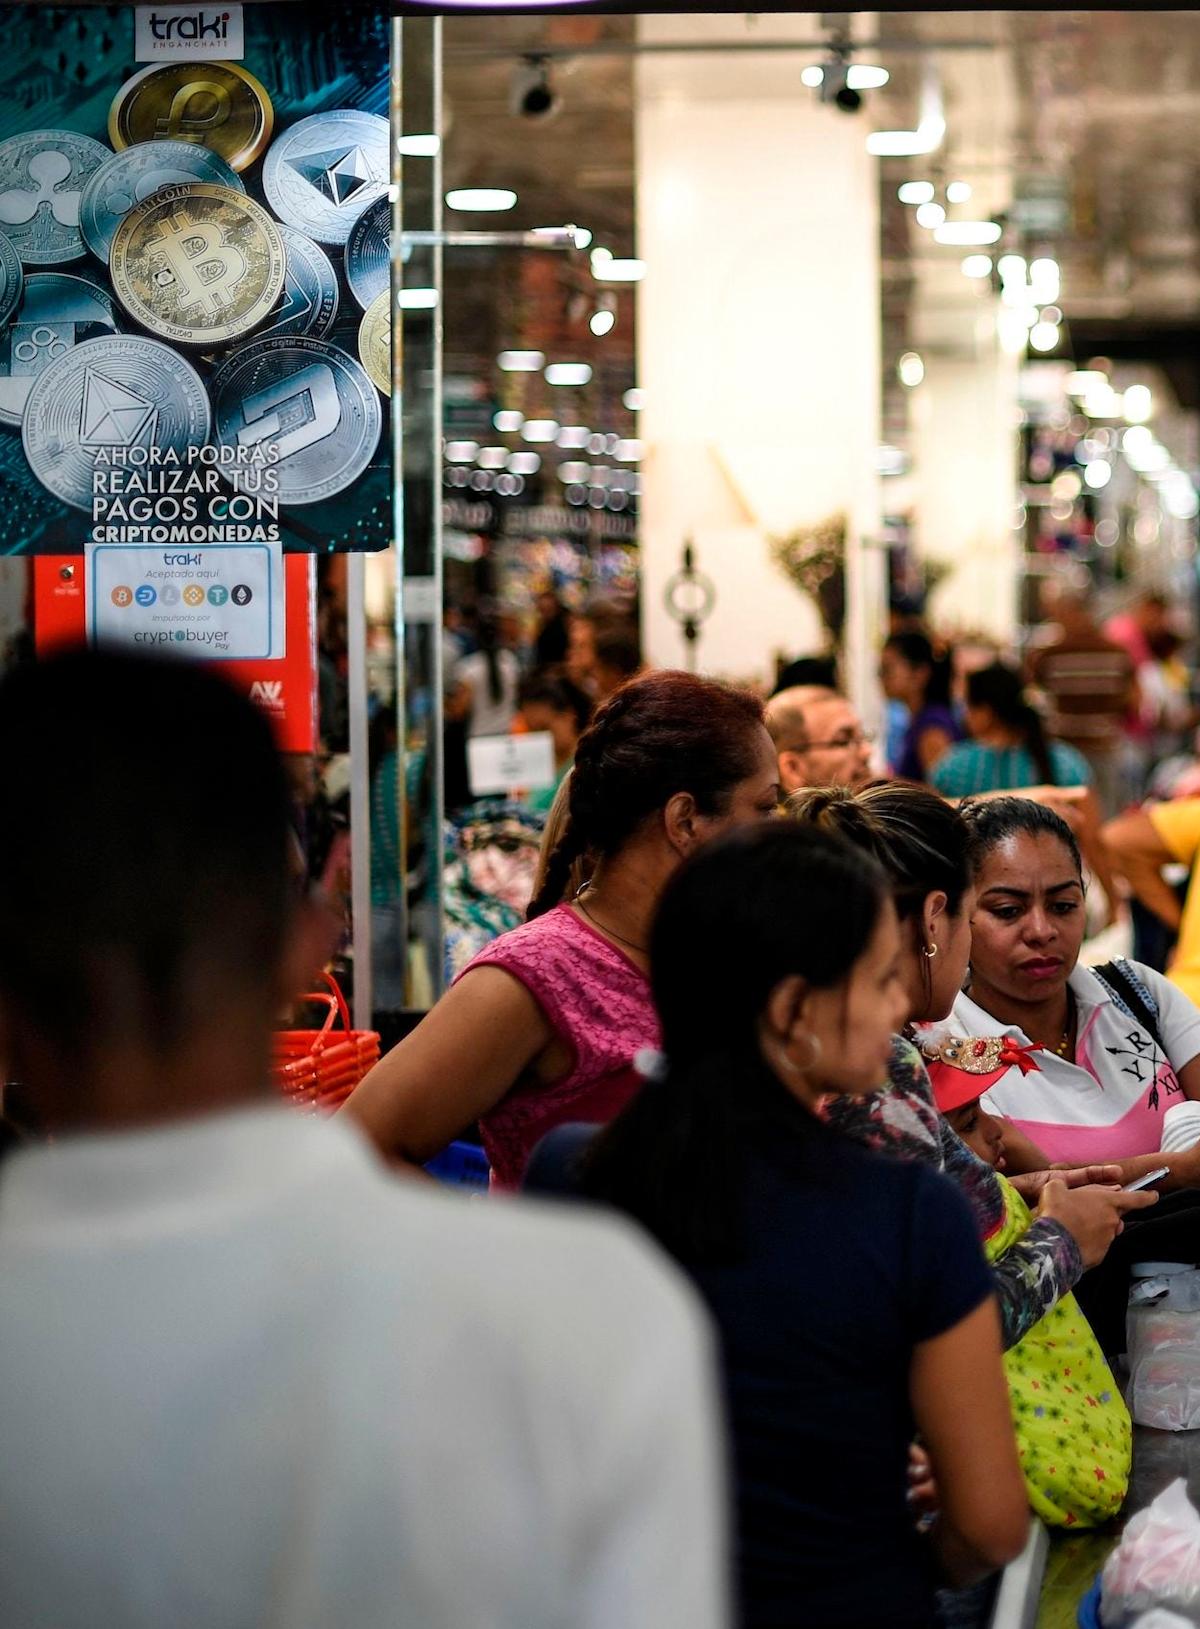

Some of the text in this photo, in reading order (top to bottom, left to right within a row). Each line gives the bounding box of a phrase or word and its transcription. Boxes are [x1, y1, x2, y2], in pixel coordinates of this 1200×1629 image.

[150, 12, 230, 39] traki
[136, 185, 191, 215] BITCOIN
[94, 439, 280, 466] AHORA PODRÁS
[93, 470, 220, 494] REALIZAR
[230, 469, 279, 493] TUS
[93, 495, 279, 522] PAGOS CON
[92, 525, 280, 543] CRIPTOMONEDAS
[163, 553, 202, 566] traki
[1125, 1031, 1152, 1053] R
[1121, 1059, 1146, 1082] Y
